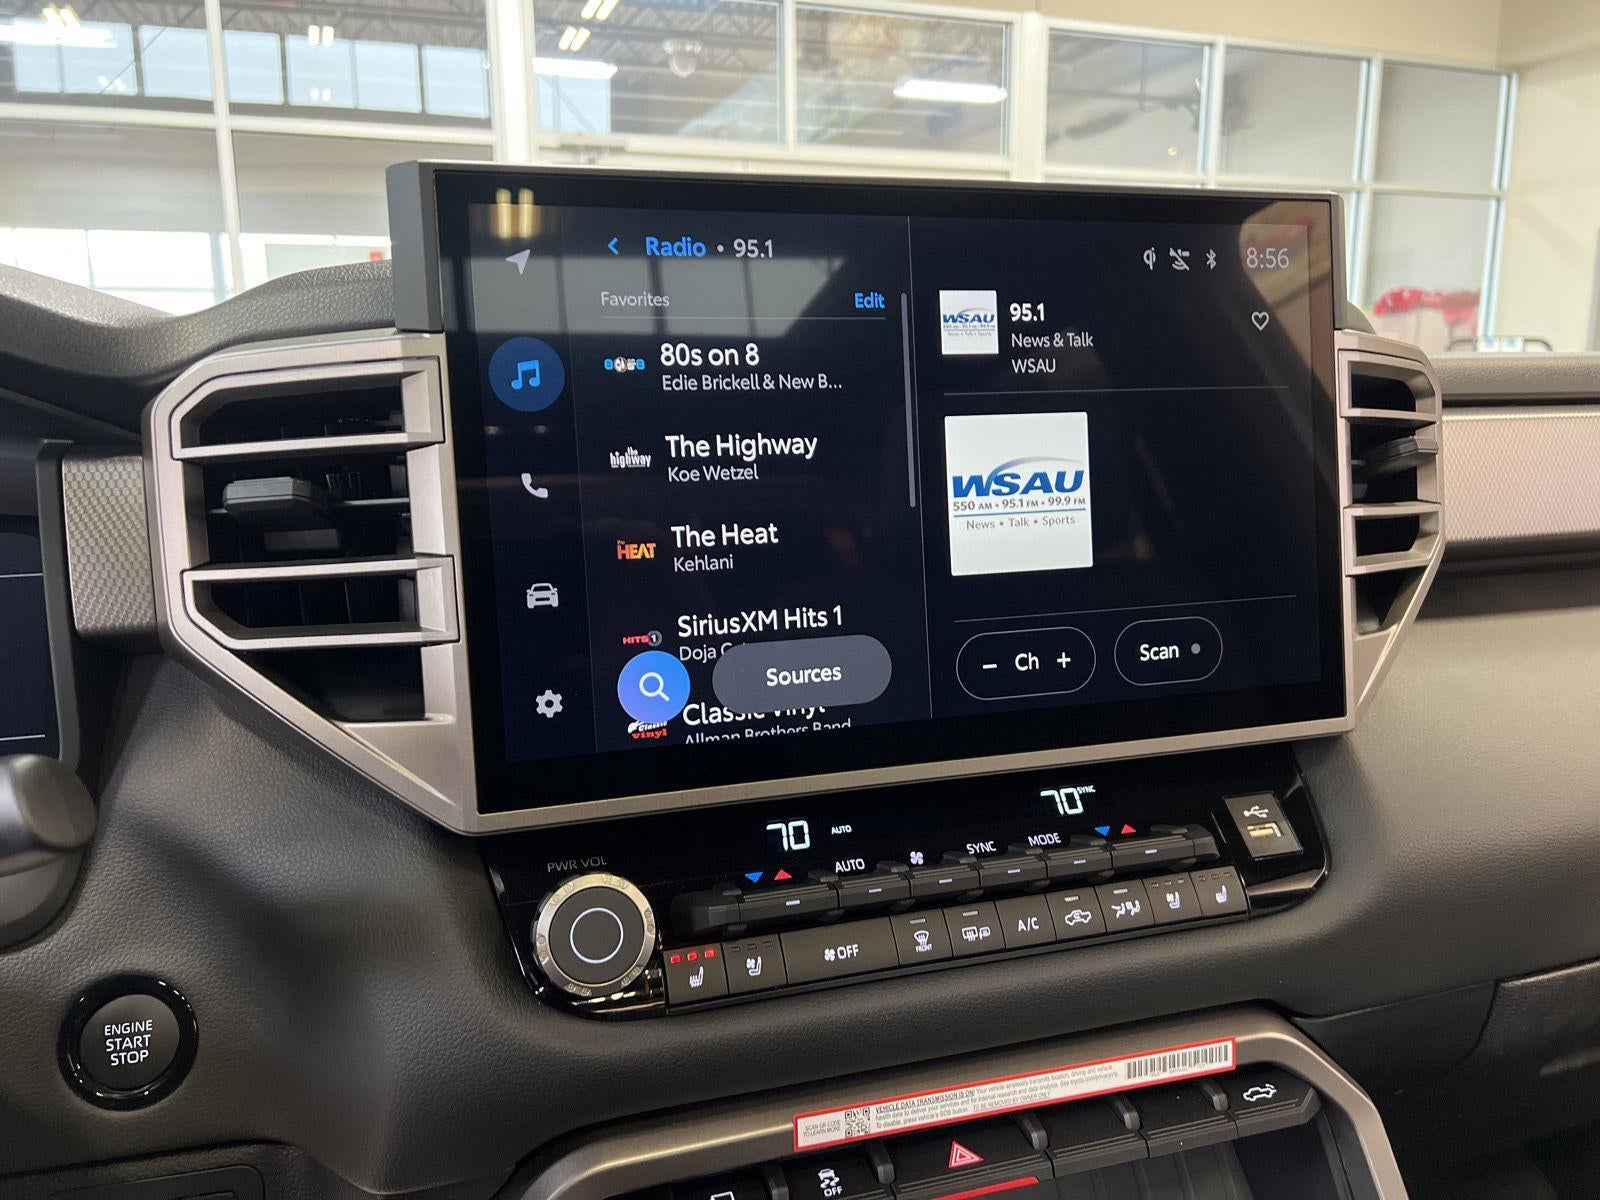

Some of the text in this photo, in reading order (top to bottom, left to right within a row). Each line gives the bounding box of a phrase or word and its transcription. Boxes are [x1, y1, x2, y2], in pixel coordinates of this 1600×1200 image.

[646, 236, 774, 258] Radio 95.1
[1246, 247, 1290, 269] 8:56
[600, 292, 670, 307] Favorites
[854, 293, 886, 309] Edit
[942, 314, 995, 323] WSAU
[1009, 302, 1046, 322] 95.1
[1011, 332, 1093, 348] News & Talk
[660, 342, 703, 367] 80s
[708, 348, 739, 366] on
[745, 342, 760, 366] 8
[1011, 357, 1057, 374] WSAU
[662, 374, 698, 391] Edie
[702, 373, 760, 390] Brickell
[762, 374, 775, 390] &
[779, 374, 814, 390] New
[665, 432, 818, 462] The Highway
[610, 451, 651, 469] highway
[668, 463, 760, 483] Koe Wetzel
[952, 470, 1085, 498] WSAU
[953, 496, 1086, 511] 550 AM 95.1 FM 99.9 FM
[966, 515, 1076, 530] News Talk Sports
[671, 523, 779, 548] The Heat
[617, 543, 657, 560] HEAT
[674, 554, 734, 572] Kehlani
[678, 605, 843, 637] SiriusXM Hits 1
[623, 635, 650, 645] HITS
[679, 644, 717, 664] Doja
[1014, 652, 1040, 671] Ch
[1139, 643, 1180, 662] Scan
[766, 665, 842, 687] Sources
[1040, 784, 1097, 815] 70 SYNC
[766, 819, 852, 851] 70 AUTO
[1027, 832, 1062, 847] MODE
[966, 841, 998, 854] SYNC
[547, 856, 608, 873] PWR VOL
[834, 858, 866, 874] AUTO
[1017, 916, 1040, 932] A/C
[836, 943, 859, 960] OFF
[104, 1019, 153, 1036] ENGINE
[105, 1034, 151, 1052] START
[110, 1049, 149, 1066] STOP
[875, 1103, 899, 1114] VEHICLE
[900, 1100, 916, 1110] DATA
[917, 1092, 957, 1107] TRANSMISSION
[823, 1185, 843, 1197] OFF
